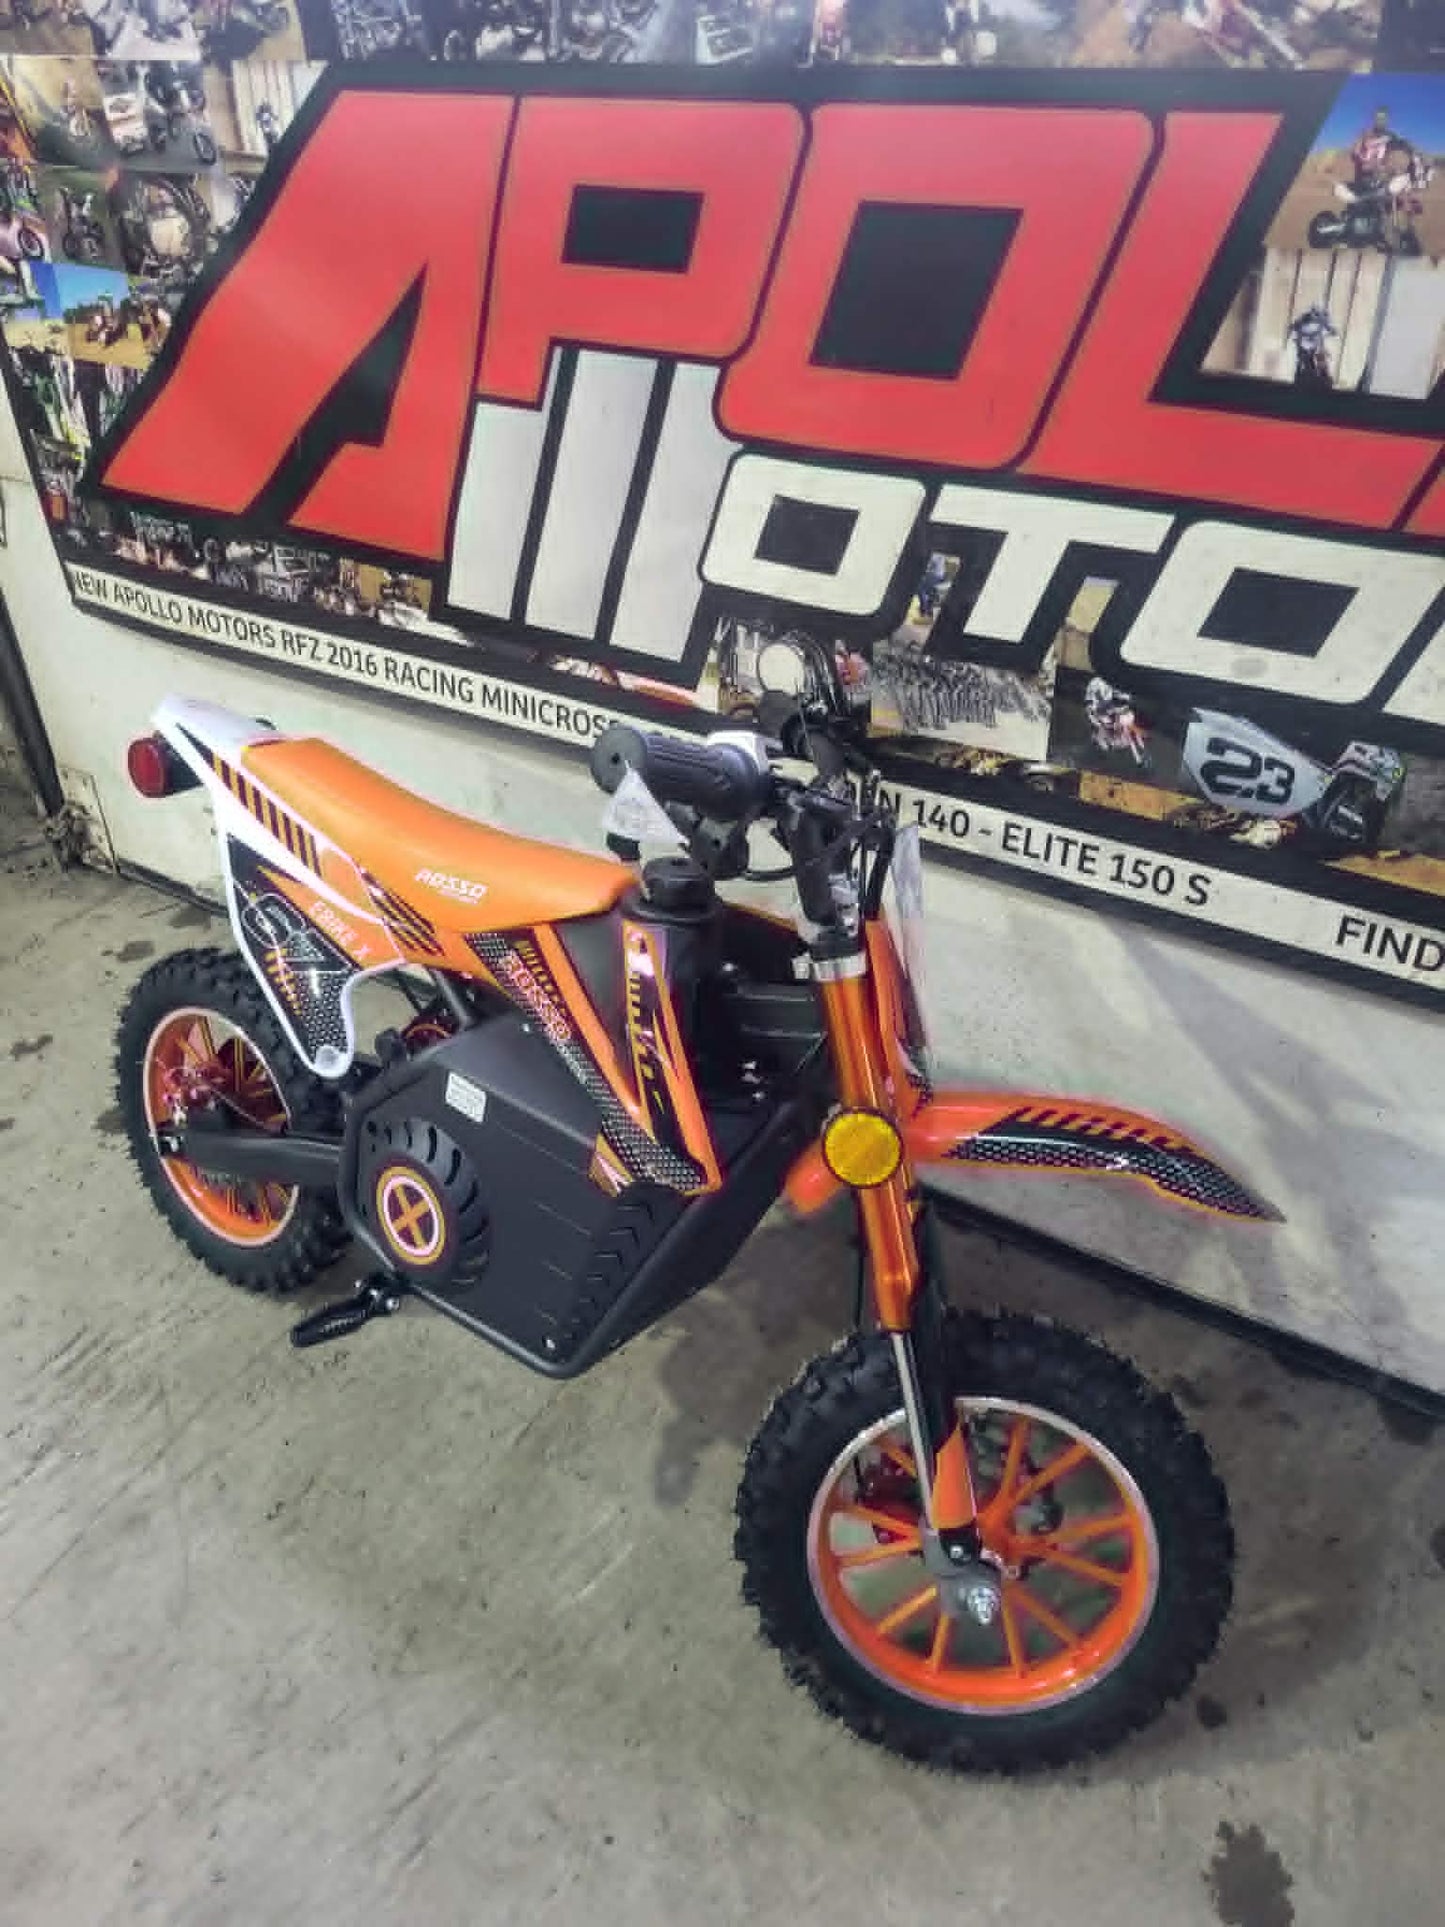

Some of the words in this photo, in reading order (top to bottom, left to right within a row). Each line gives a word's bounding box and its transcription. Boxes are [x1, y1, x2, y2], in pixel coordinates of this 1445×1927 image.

[102, 90, 1445, 561] APOL
[447, 350, 1445, 727] MOTO
[113, 584, 183, 625] APOLLO
[188, 605, 276, 648] MOTORS
[280, 629, 324, 663] RFZ
[326, 646, 379, 677] 2016
[384, 656, 475, 704] RACING
[481, 684, 620, 737] MINICROS
[1200, 736, 1296, 804] 23
[912, 800, 970, 839] 140
[1001, 821, 1099, 875] ELITE
[1109, 853, 1176, 895] 150
[1185, 873, 1212, 905] S
[1335, 914, 1445, 972] FIND
